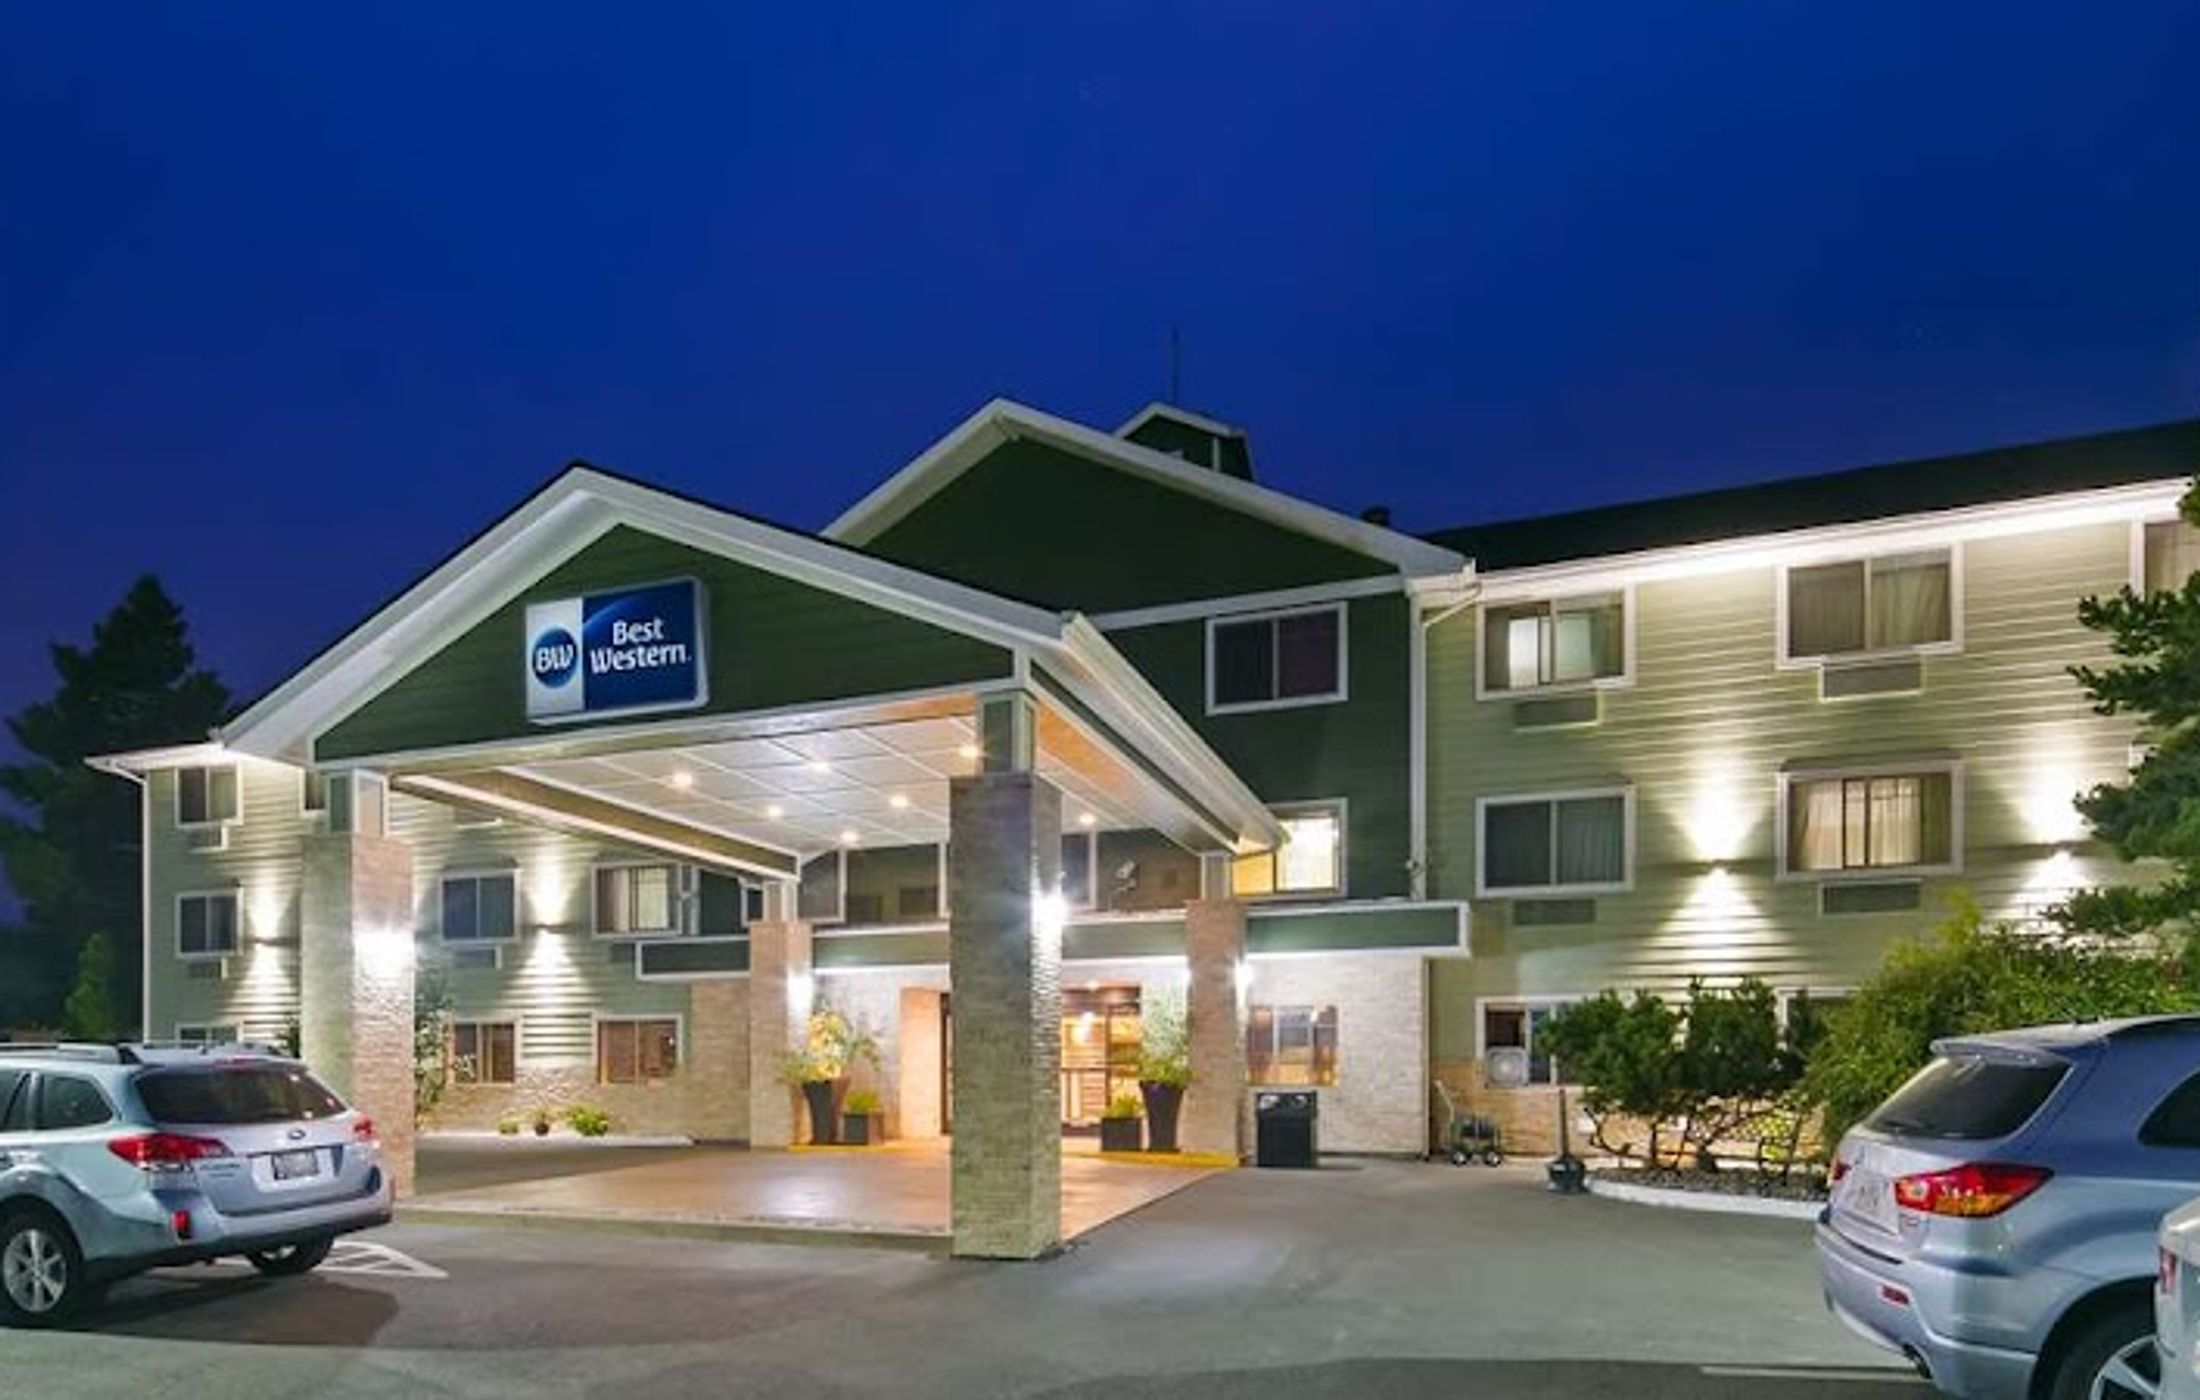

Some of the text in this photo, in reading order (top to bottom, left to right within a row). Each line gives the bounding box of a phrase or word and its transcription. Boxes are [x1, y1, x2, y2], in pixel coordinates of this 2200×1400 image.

[612, 617, 664, 645] Best
[535, 644, 574, 673] BW
[590, 644, 687, 674] Western
